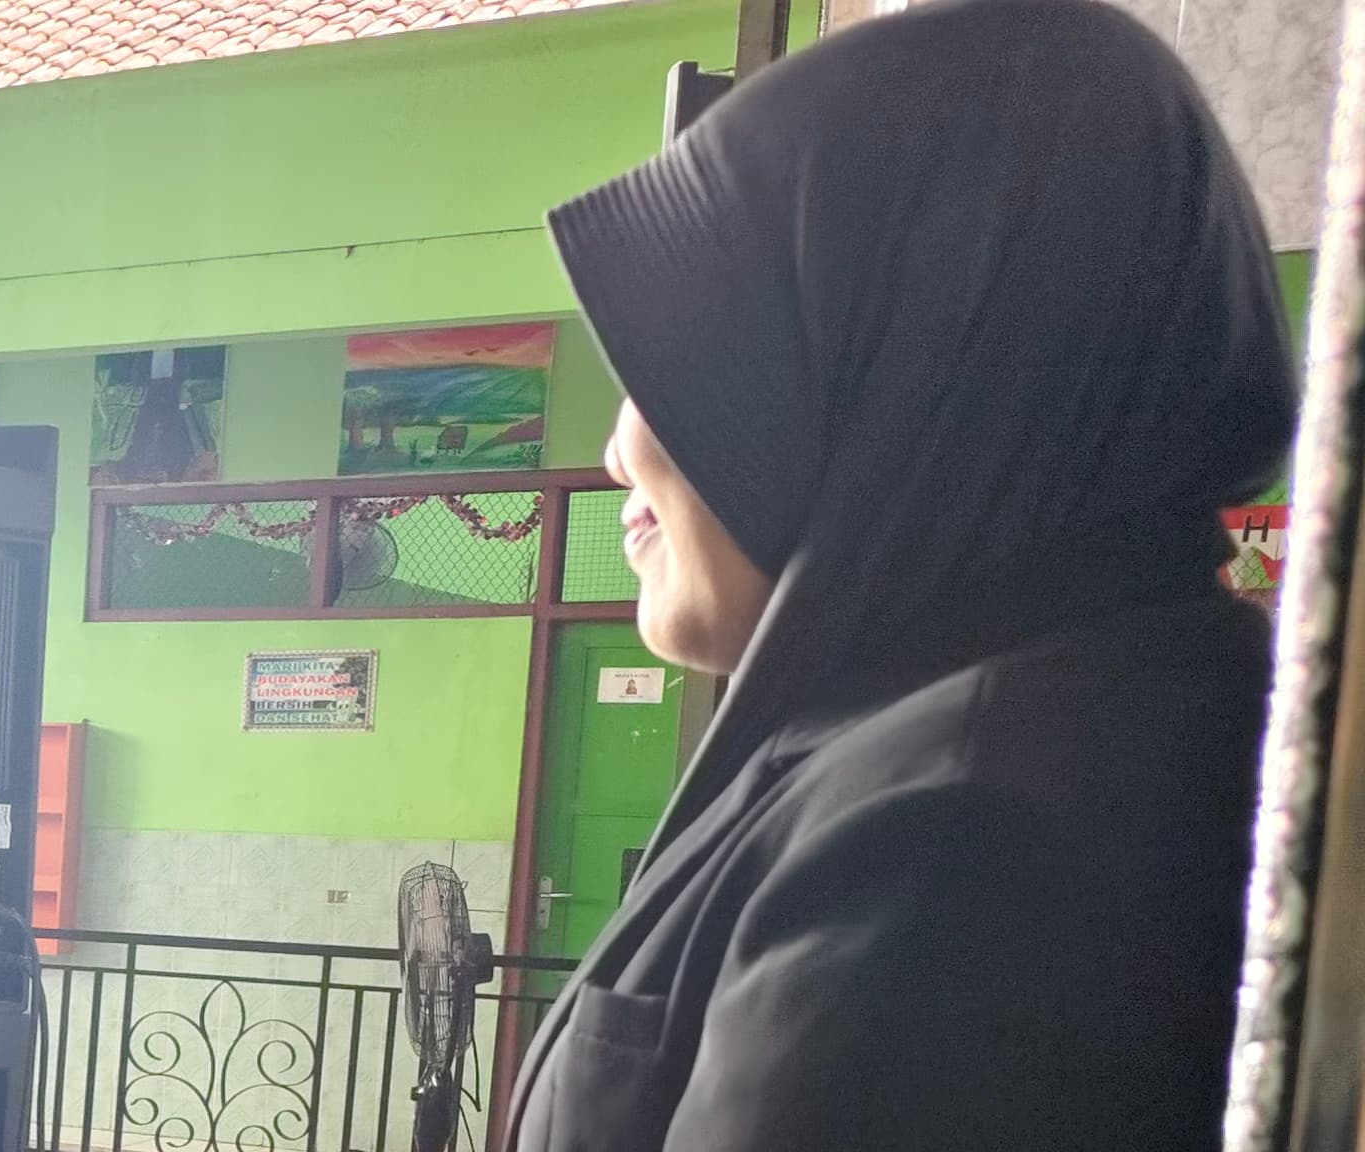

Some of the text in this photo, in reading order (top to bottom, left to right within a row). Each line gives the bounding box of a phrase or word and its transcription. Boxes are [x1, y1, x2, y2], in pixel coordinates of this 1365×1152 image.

[258, 661, 336, 672] MARI KITA
[257, 673, 350, 684] BUDAYAKAN
[257, 686, 357, 697] LINGKUNGAN
[256, 699, 311, 709] BERSIH
[255, 712, 337, 722] DAN SEHAT
